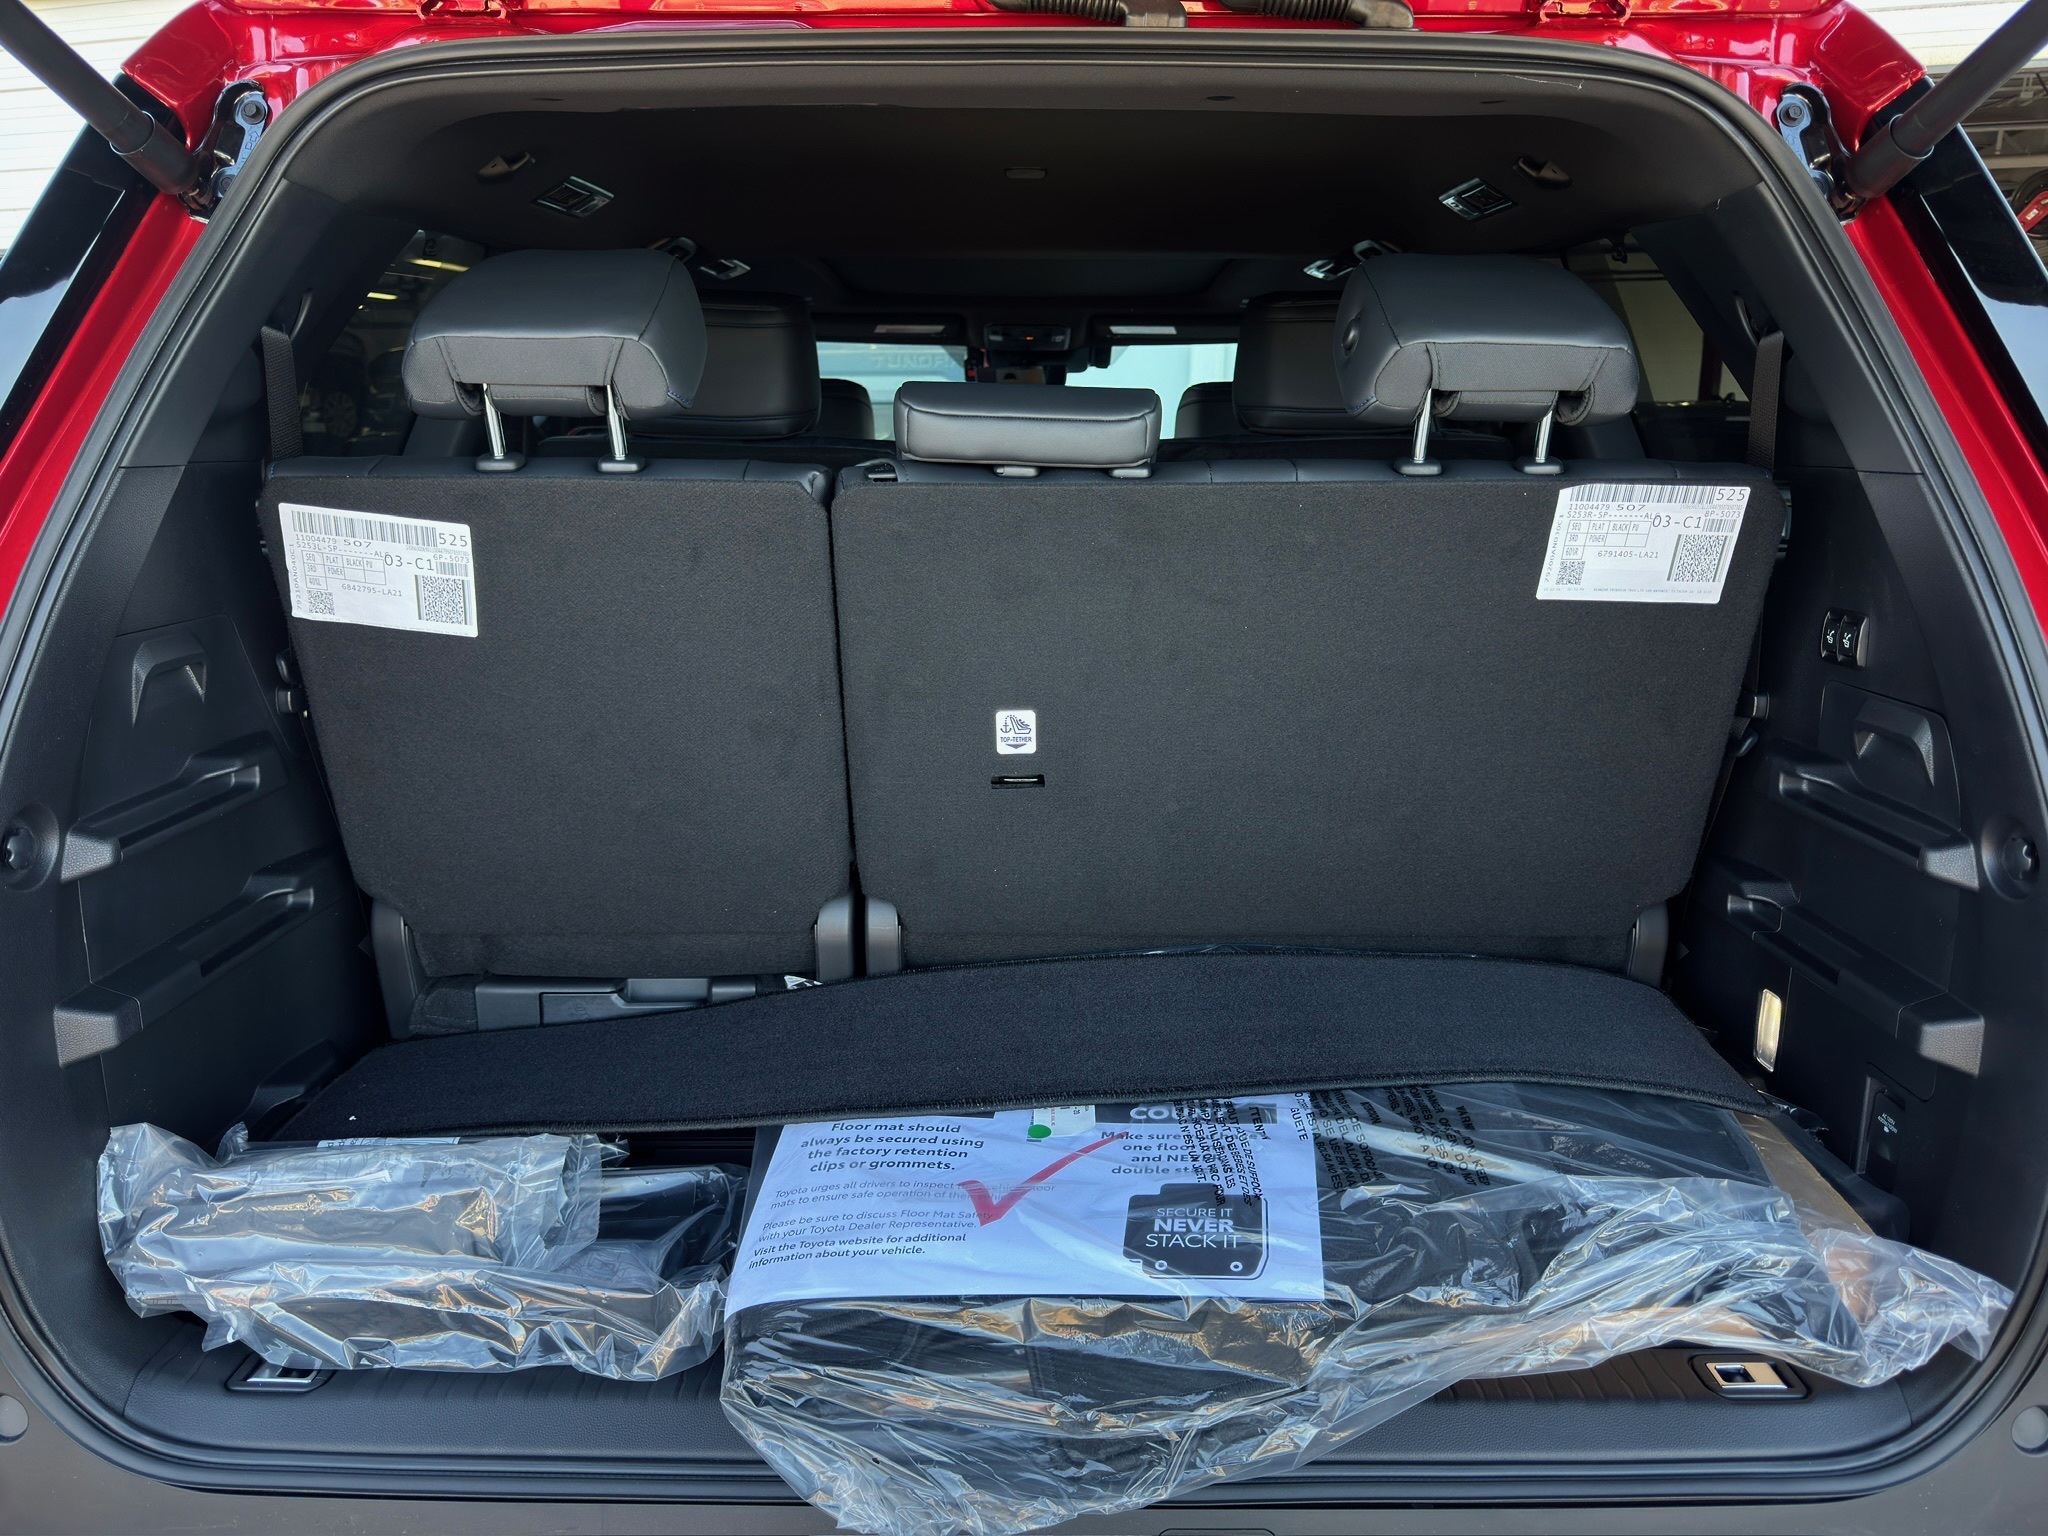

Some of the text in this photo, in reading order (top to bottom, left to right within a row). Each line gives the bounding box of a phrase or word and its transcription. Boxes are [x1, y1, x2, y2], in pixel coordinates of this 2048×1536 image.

[1716, 489, 1747, 501] 525
[1568, 503, 1646, 512] 11004479 507
[1704, 510, 1741, 519] 8P-5073
[1591, 522, 1605, 531] PLAT
[1612, 523, 1629, 532] BLACK
[1652, 514, 1702, 529] 03-C1
[295, 533, 372, 549] 11004479 507
[438, 532, 468, 547] 525
[325, 555, 338, 564] PLAT
[346, 557, 363, 567] BLACK
[385, 553, 435, 571] 03-C1
[432, 553, 470, 564] 6P-5073
[1597, 550, 1659, 559] 6791405-LA21
[341, 583, 403, 597] 6842795-LA21
[831, 1122, 961, 1134] Floor mat should
[1290, 1107, 1309, 1142] GUETE
[1322, 1119, 1335, 1137] SE
[1335, 1116, 1349, 1141] DEL
[1350, 1115, 1362, 1132] DE
[800, 1134, 985, 1149] always be secured using
[1101, 1131, 1143, 1140] Make
[1147, 1132, 1181, 1140] sure
[807, 1147, 969, 1159] the factory retention
[1243, 1149, 1254, 1160] DE
[1305, 1111, 1322, 1141] ESTA
[1330, 1174, 1344, 1190] ES
[1420, 1144, 1431, 1153] A
[1131, 1153, 1162, 1163] and
[1455, 1152, 1469, 1171] DO
[809, 1160, 956, 1173] clips or grommets.
[1111, 1164, 1171, 1174] double
[1224, 1174, 1236, 1189] LES
[775, 1187, 809, 1199] Toyota
[810, 1183, 841, 1195] urges
[842, 1181, 857, 1190] all
[858, 1180, 897, 1189] drivers
[913, 1181, 955, 1193] inspect
[770, 1199, 796, 1210] mats
[798, 1196, 810, 1205] to
[811, 1193, 849, 1203] ensure
[851, 1190, 874, 1199] safe
[876, 1189, 932, 1200] operation
[934, 1189, 948, 1199] of
[1157, 1207, 1233, 1218] SECURE IT
[763, 1210, 993, 1231] Please be sure to discuss Floor Mat Safety
[1153, 1218, 1234, 1234] NEVER
[758, 1220, 977, 1243] with your Toyota Dealer Representative.
[753, 1233, 967, 1258] Visit the Toyota website for additional
[1145, 1233, 1242, 1249] STACK IT
[748, 1246, 926, 1270] information about your vehicle.
